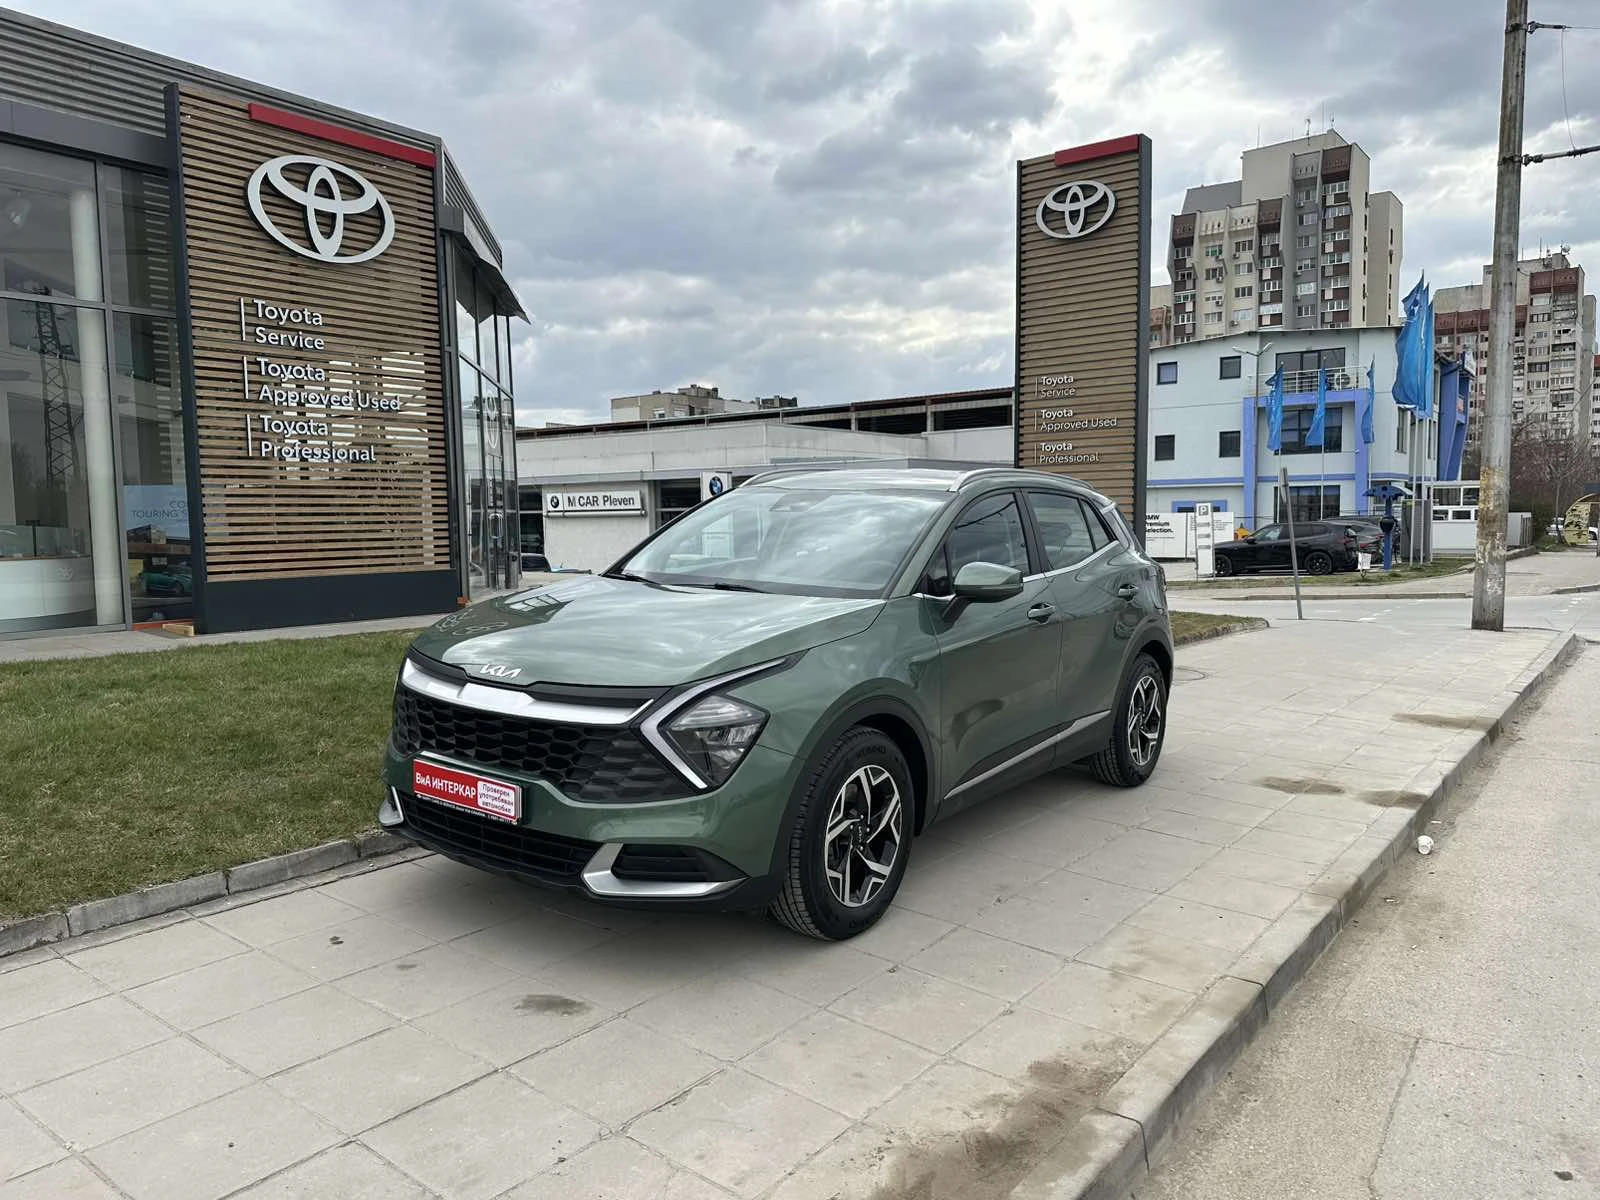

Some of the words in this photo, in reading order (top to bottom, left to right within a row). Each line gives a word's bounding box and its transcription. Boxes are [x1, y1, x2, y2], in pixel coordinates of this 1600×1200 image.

[253, 299, 324, 326] Toyota
[255, 326, 325, 350] Service
[256, 357, 327, 382] Toyota
[1040, 374, 1074, 387] Toyota
[259, 384, 354, 407] Approved
[357, 390, 401, 411] Used
[1040, 387, 1076, 398] Service
[1040, 408, 1073, 420] Toyota
[260, 415, 329, 438] Toyota
[1040, 420, 1088, 432] Approved
[1091, 417, 1117, 428] Used
[261, 441, 377, 462] Professional
[1040, 441, 1073, 453] Toyota
[1039, 452, 1100, 464] Professional
[578, 495, 600, 507] CAR
[602, 494, 635, 507] Pleven
[131, 510, 178, 519] TOURING
[431, 779, 477, 799] ИНТЕРКАР
